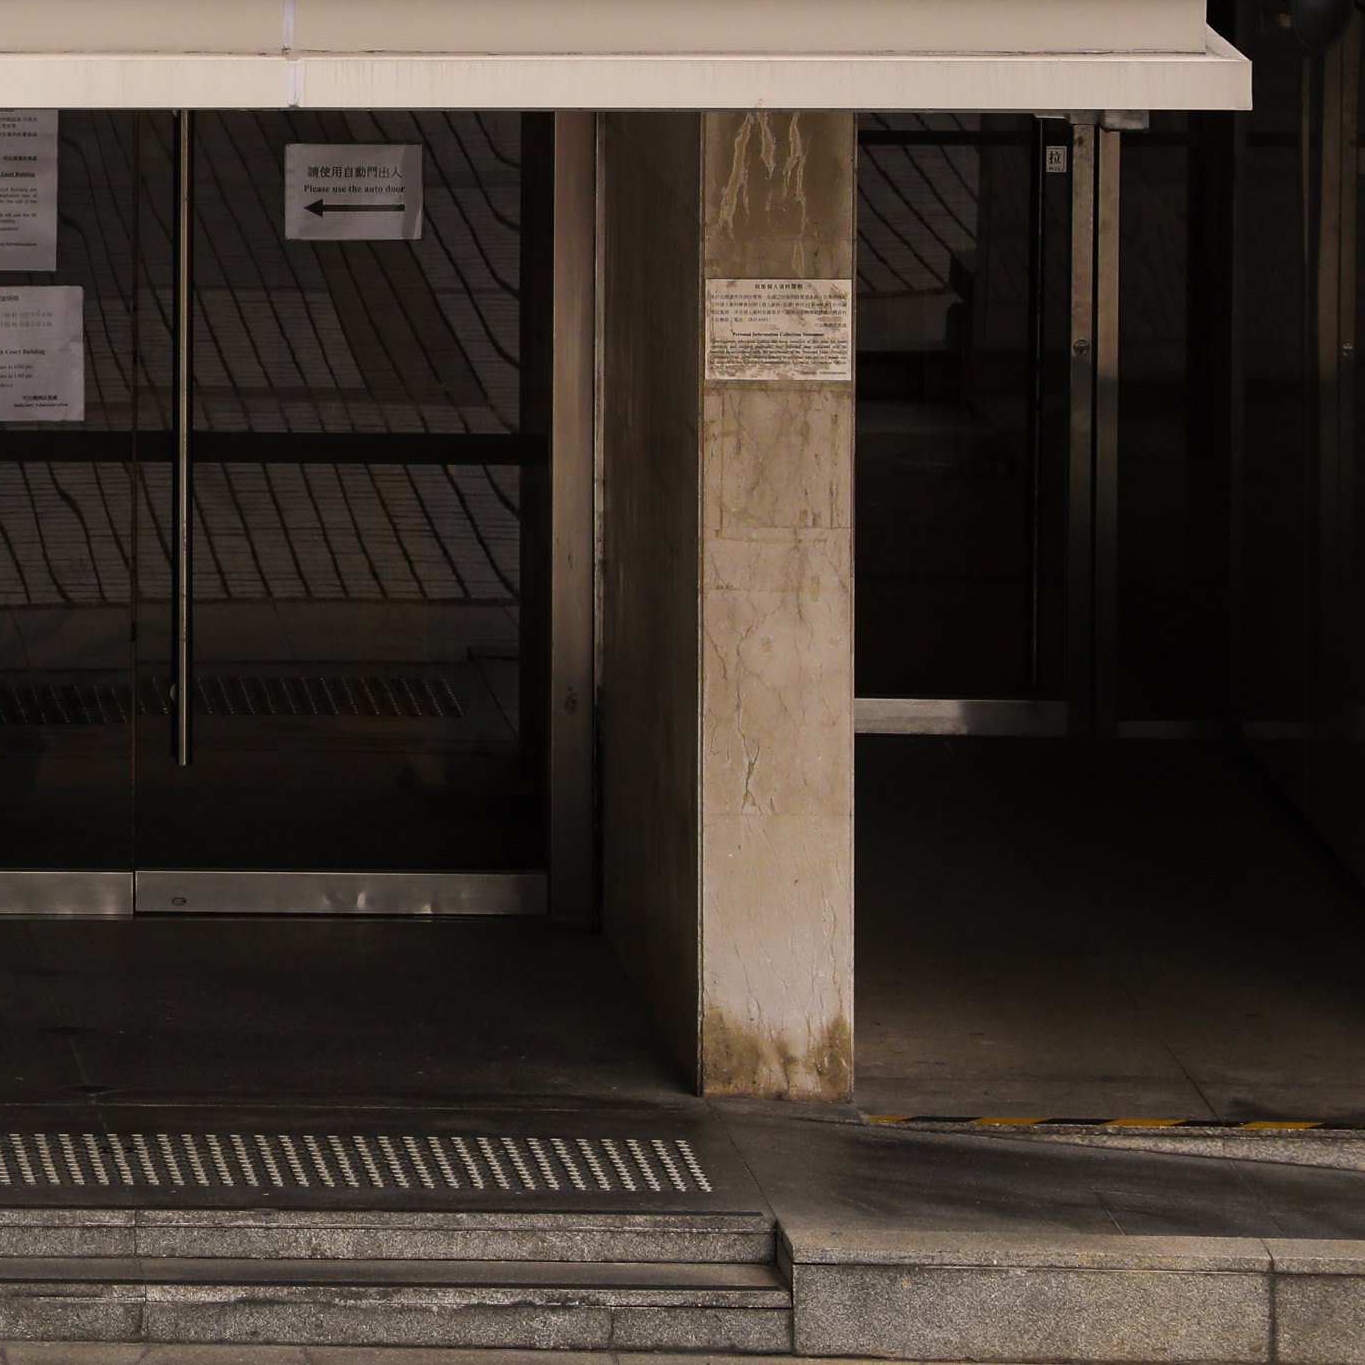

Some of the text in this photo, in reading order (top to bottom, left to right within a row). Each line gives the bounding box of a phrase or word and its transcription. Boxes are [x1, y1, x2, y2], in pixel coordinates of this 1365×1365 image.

[304, 185, 405, 193] Please use the auto door
